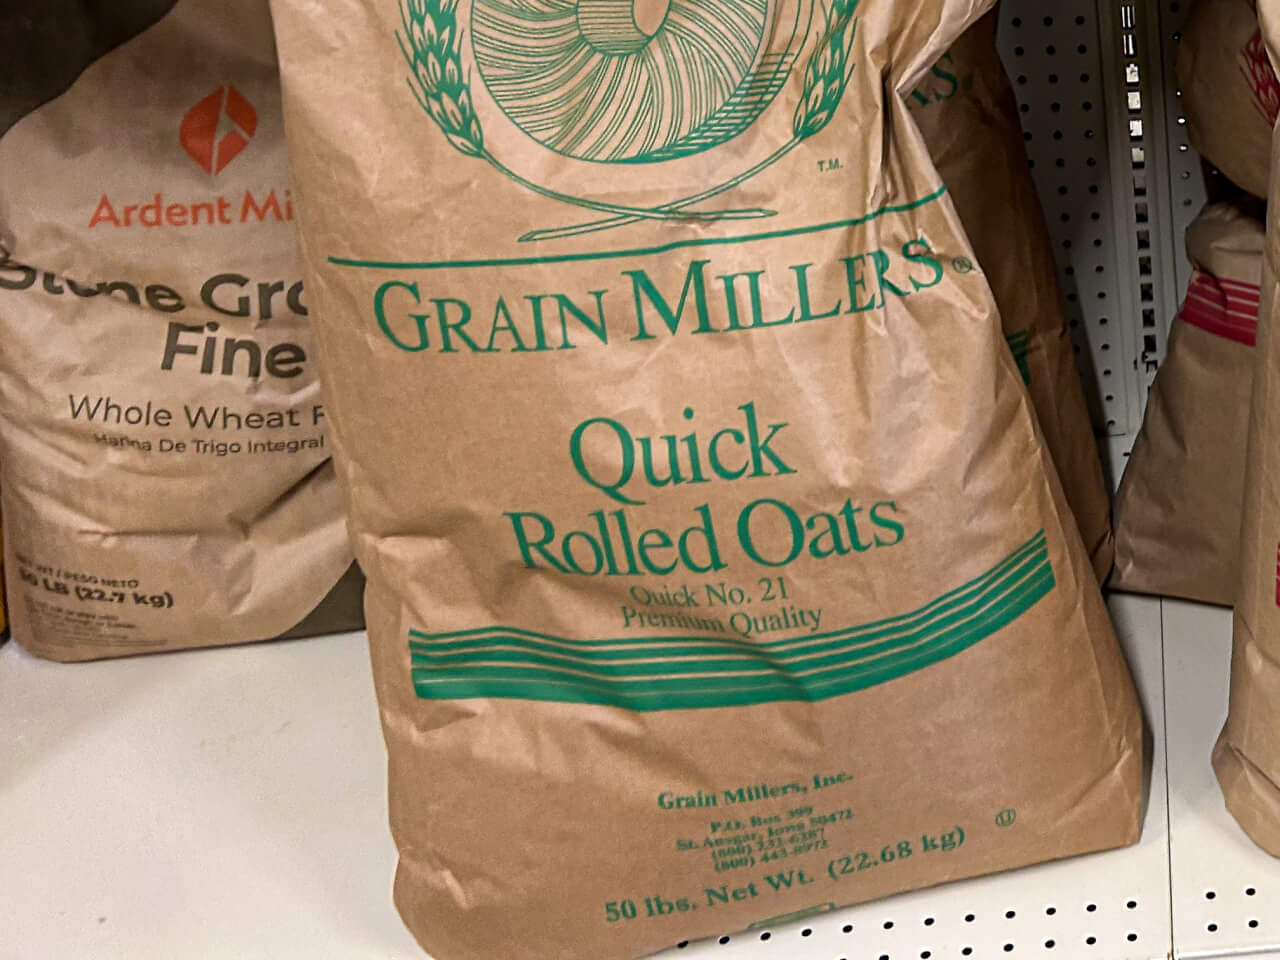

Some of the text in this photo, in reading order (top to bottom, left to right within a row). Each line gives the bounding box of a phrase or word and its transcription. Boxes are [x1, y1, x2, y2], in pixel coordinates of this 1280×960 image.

[88, 192, 231, 229] Ardent
[200, 272, 309, 321] Gro
[373, 236, 946, 354] GRAIN MILLERS
[160, 321, 307, 379] Fine
[67, 393, 300, 430] Whole Wheat
[159, 439, 187, 454] De
[194, 439, 241, 457] Trigo
[248, 434, 325, 455] Integral
[569, 400, 798, 505] Quick
[502, 496, 906, 577] Rolled Oats
[132, 591, 175, 609] kg)
[629, 576, 789, 608] Quick No. 21
[620, 604, 823, 639] Premium Quality
[657, 790, 717, 810] Grain
[723, 782, 808, 806] Millers,
[604, 825, 967, 924] 50 lbs. Net Wt. (22.68 kg)
